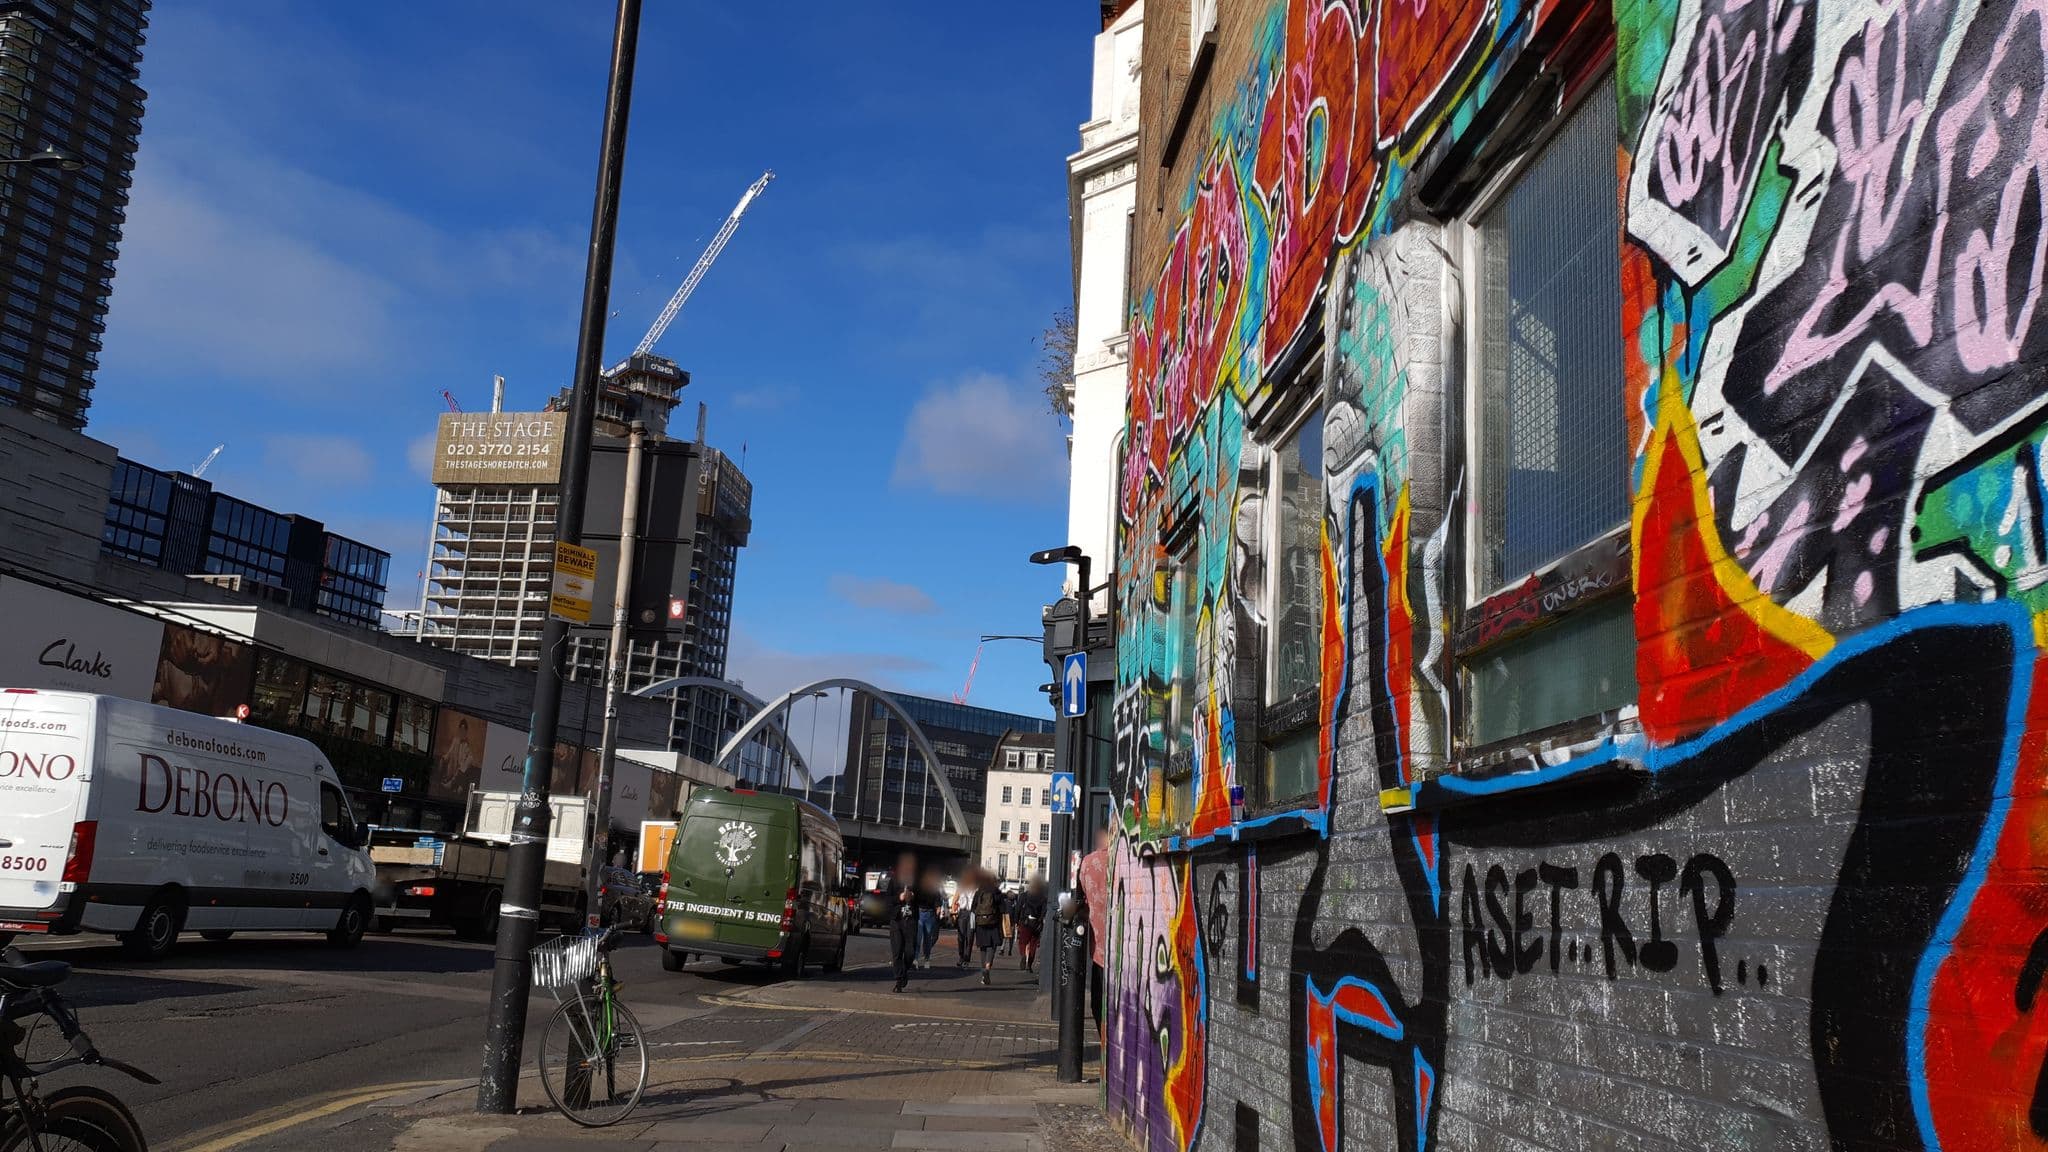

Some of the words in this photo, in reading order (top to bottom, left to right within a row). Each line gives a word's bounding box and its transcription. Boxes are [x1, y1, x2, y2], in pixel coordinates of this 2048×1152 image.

[450, 421, 488, 437] THE
[494, 421, 553, 437] STAGE
[447, 444, 474, 455] 020
[478, 444, 512, 455] 3770
[517, 444, 550, 455] 2154
[445, 460, 548, 469] THESTAGESHOREDITCH.COM
[558, 554, 594, 570] BEWARE
[559, 547, 595, 561] CRIMINALS
[38, 639, 112, 678] Clarks
[167, 730, 266, 762] debonofoods.com
[134, 752, 289, 827] DEBONO
[718, 821, 757, 838] BELAZU
[147, 837, 187, 856] delivering
[2, 856, 47, 871] 8500
[289, 873, 309, 885] 8500
[667, 900, 685, 910] THE
[686, 903, 744, 918] INGREDIENT
[745, 911, 755, 919] IS
[756, 912, 781, 923] KING
